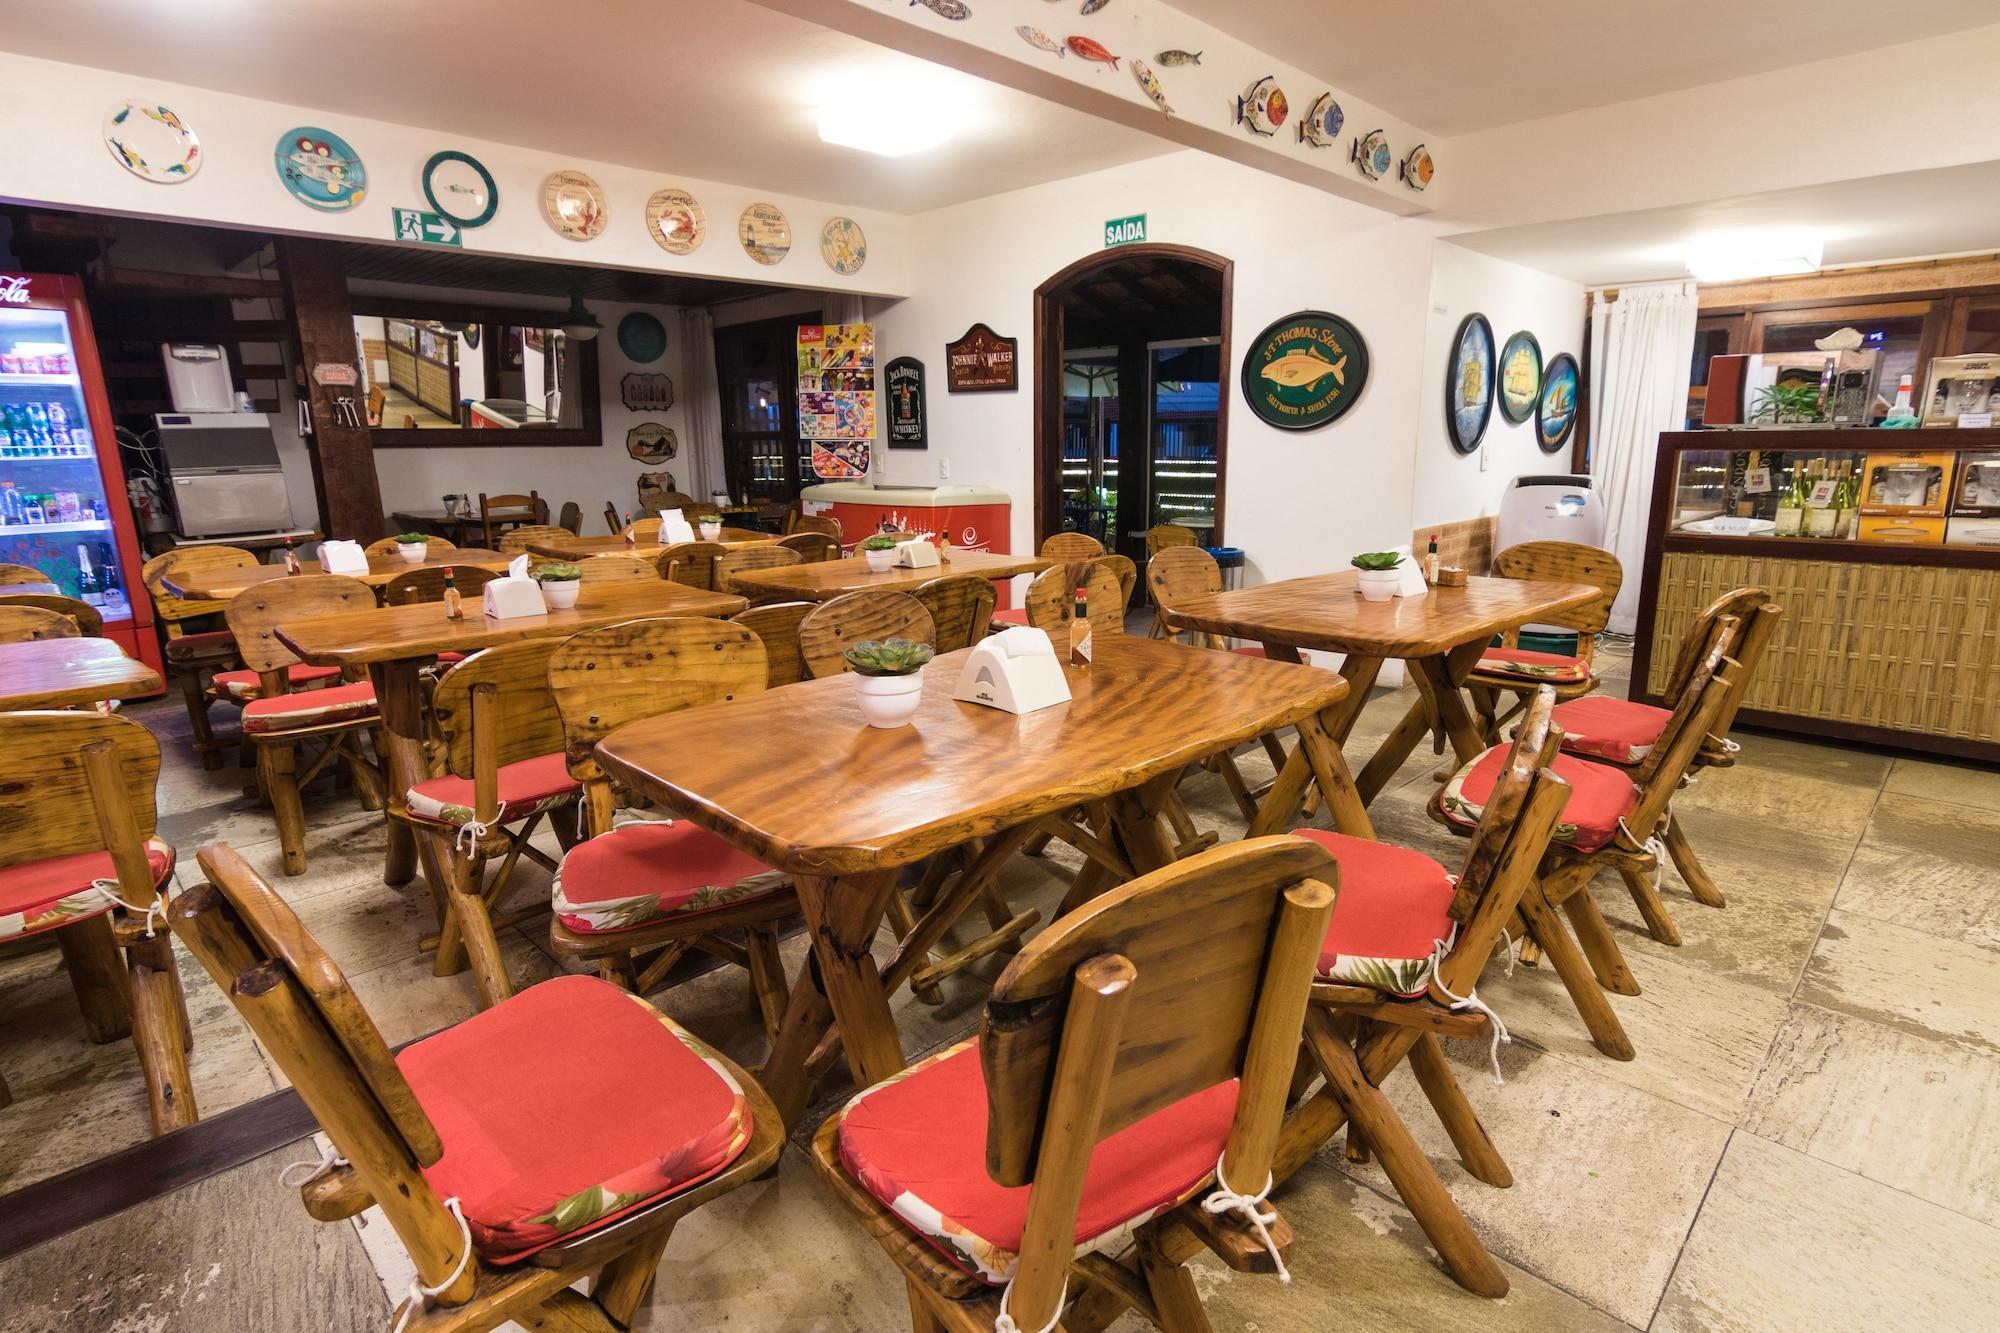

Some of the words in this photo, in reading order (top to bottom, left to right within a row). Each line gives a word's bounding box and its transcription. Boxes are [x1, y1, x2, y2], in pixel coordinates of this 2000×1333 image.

[1107, 219, 1145, 245] SAÍDA
[952, 354, 978, 370] JOHNNIE
[987, 351, 1013, 368] WALKER
[894, 424, 919, 434] WHISKEY
